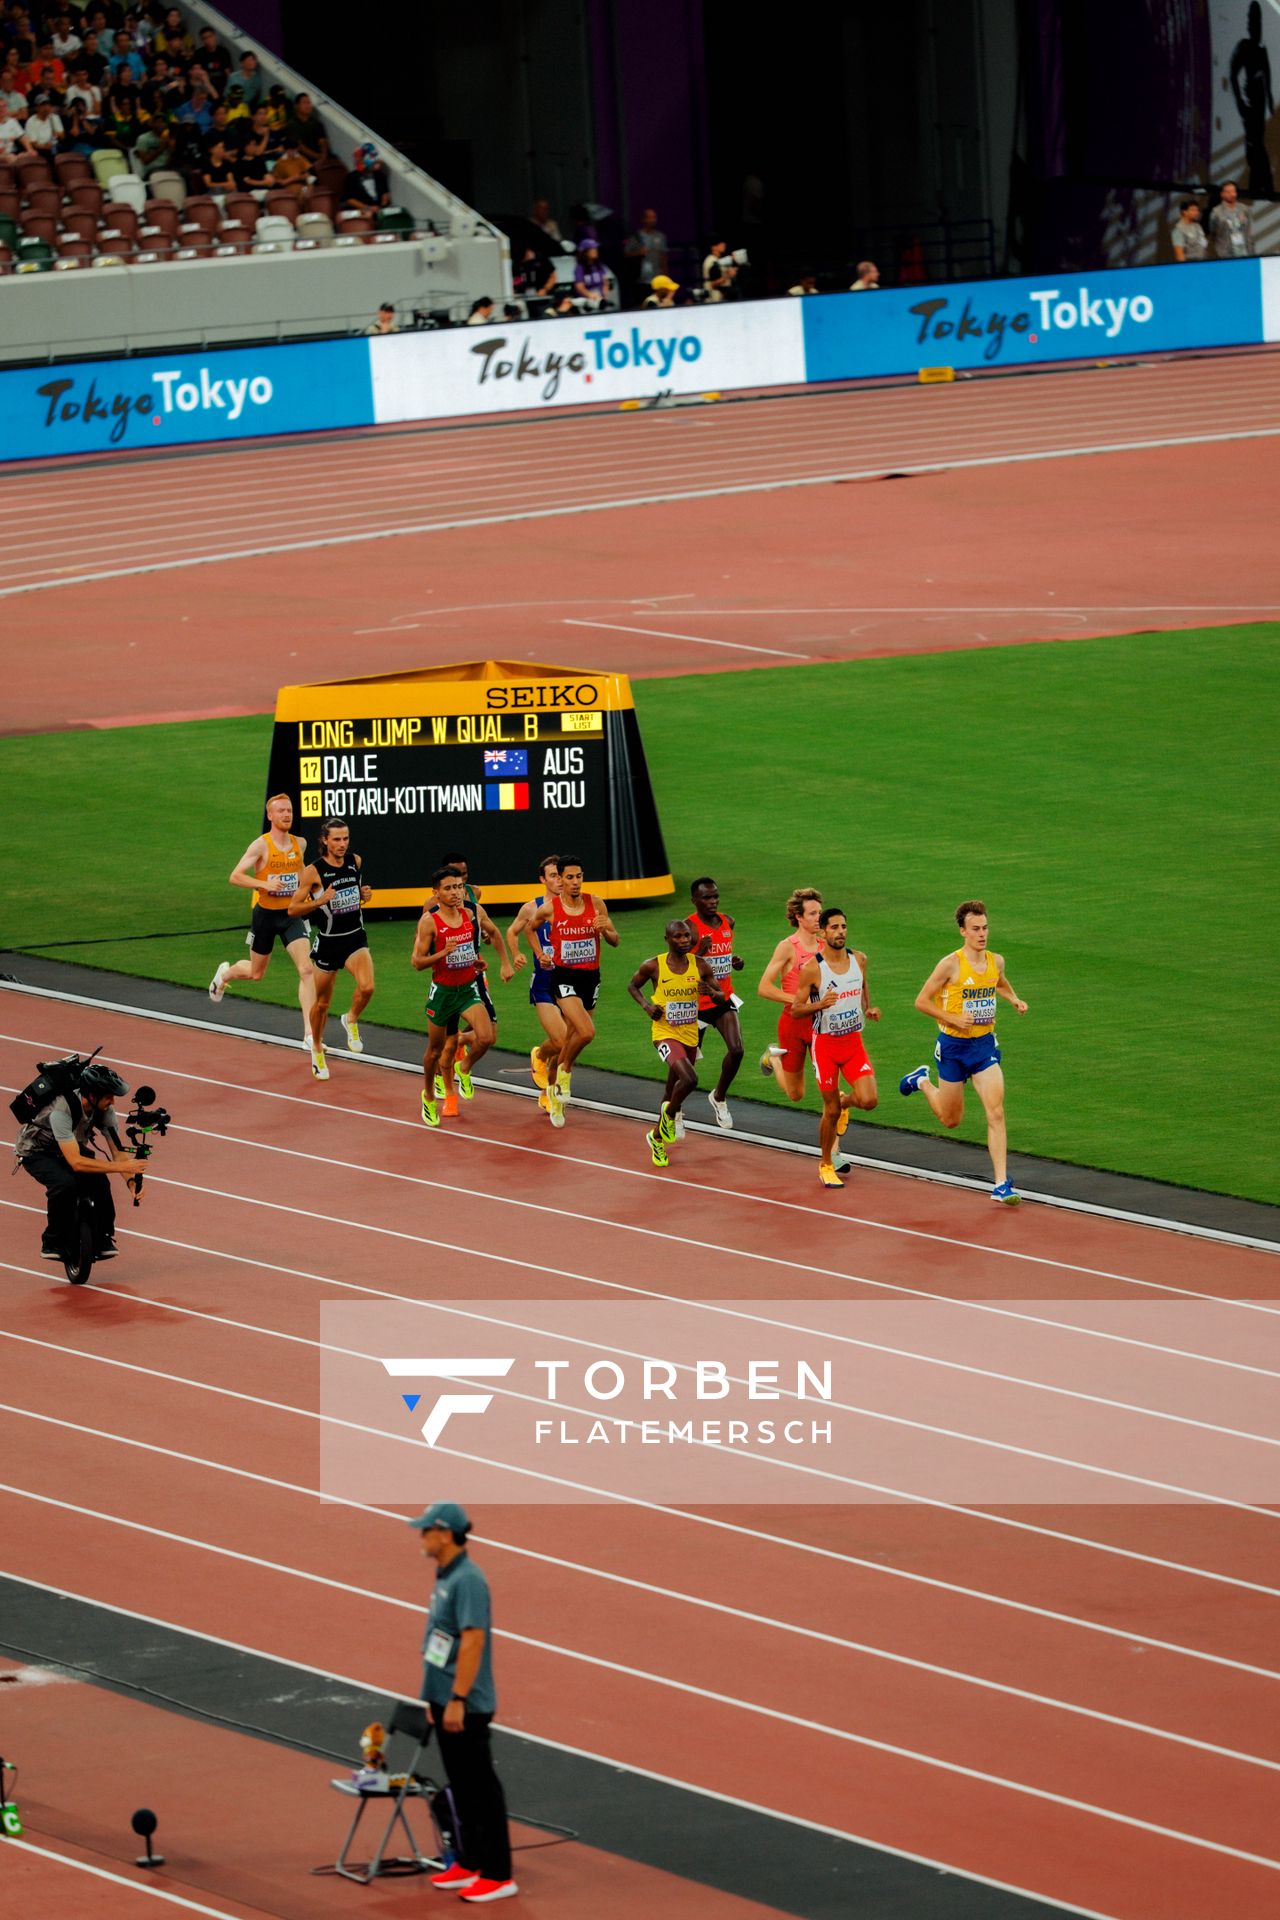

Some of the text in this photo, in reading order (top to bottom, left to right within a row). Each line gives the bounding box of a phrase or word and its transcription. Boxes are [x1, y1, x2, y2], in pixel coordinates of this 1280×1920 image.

[910, 287, 1155, 361] Tokyo Tokyo
[470, 329, 702, 400] Tokyo Tokyo
[37, 367, 273, 442] Tokyo Tokyo
[486, 684, 598, 709] SEIKO
[569, 713, 594, 722] START
[299, 713, 539, 750] LONG JUMP W QUAL. B
[573, 722, 592, 730] LIST
[302, 747, 584, 783] 17 DALE AUS
[303, 780, 586, 817] 18 ROTARU-KOTTMANN ROU
[279, 873, 297, 882] TDK
[338, 887, 358, 898] TDK
[331, 895, 360, 909] BEAMISH
[558, 926, 596, 936] TUNISIA
[457, 943, 473, 953] TDK
[571, 940, 593, 949] TDK
[447, 954, 460, 963] BEN
[713, 956, 731, 964] TDK
[563, 985, 571, 994] 7
[663, 987, 697, 997] UGANDA
[962, 986, 995, 999] SWEDEN
[676, 1000, 697, 1010] TDK
[973, 999, 995, 1008] TDK
[837, 1008, 858, 1020] TDK
[829, 1016, 860, 1031] GILAVERT
[658, 1043, 670, 1058] 12
